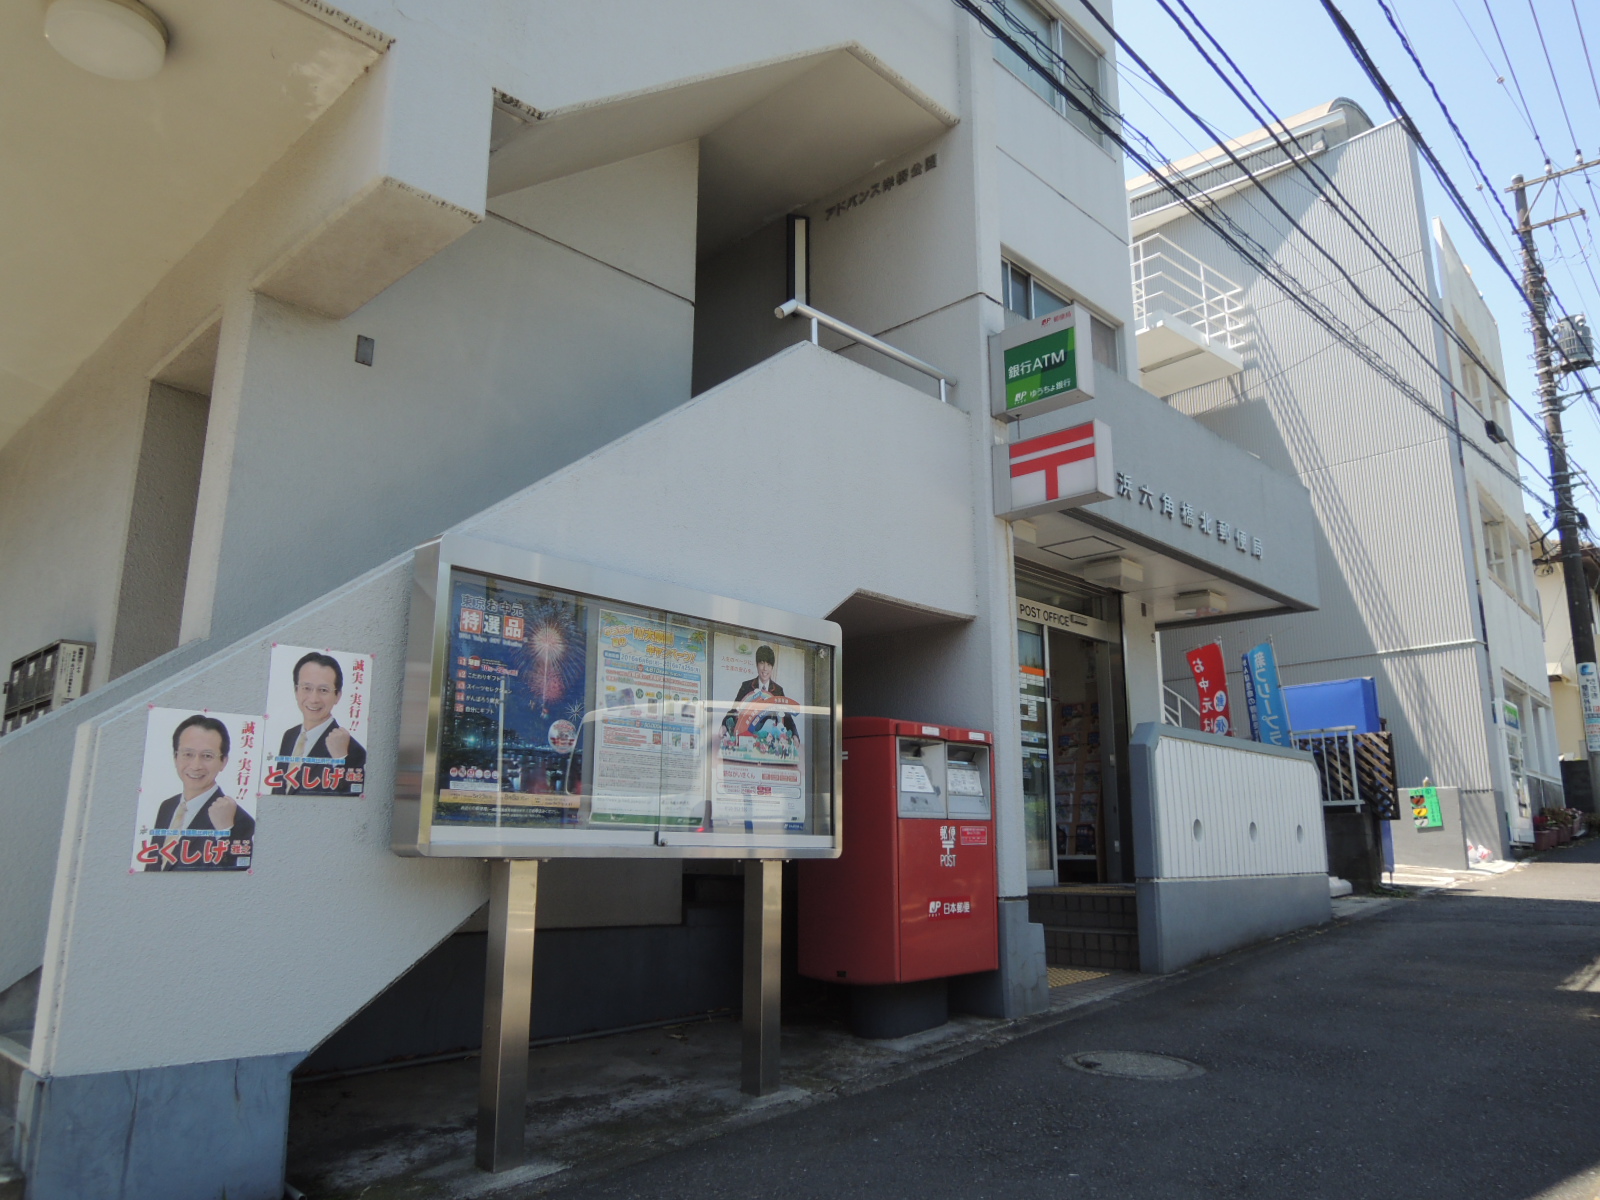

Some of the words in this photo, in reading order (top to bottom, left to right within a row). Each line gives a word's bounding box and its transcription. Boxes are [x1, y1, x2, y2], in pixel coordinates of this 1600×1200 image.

[1008, 349, 1065, 379] 銀行ATM
[1030, 378, 1071, 398] ゆうちょ銀行
[460, 593, 524, 618] 東京お中元
[1019, 604, 1041, 620] POST
[1043, 610, 1070, 627] OFFICE
[461, 610, 522, 639] 特選品
[264, 766, 345, 790] とくしげ
[940, 825, 956, 841] 郵便
[136, 839, 230, 864] とくしげ
[940, 854, 956, 867] POST
[944, 901, 970, 914] 日本郵便
